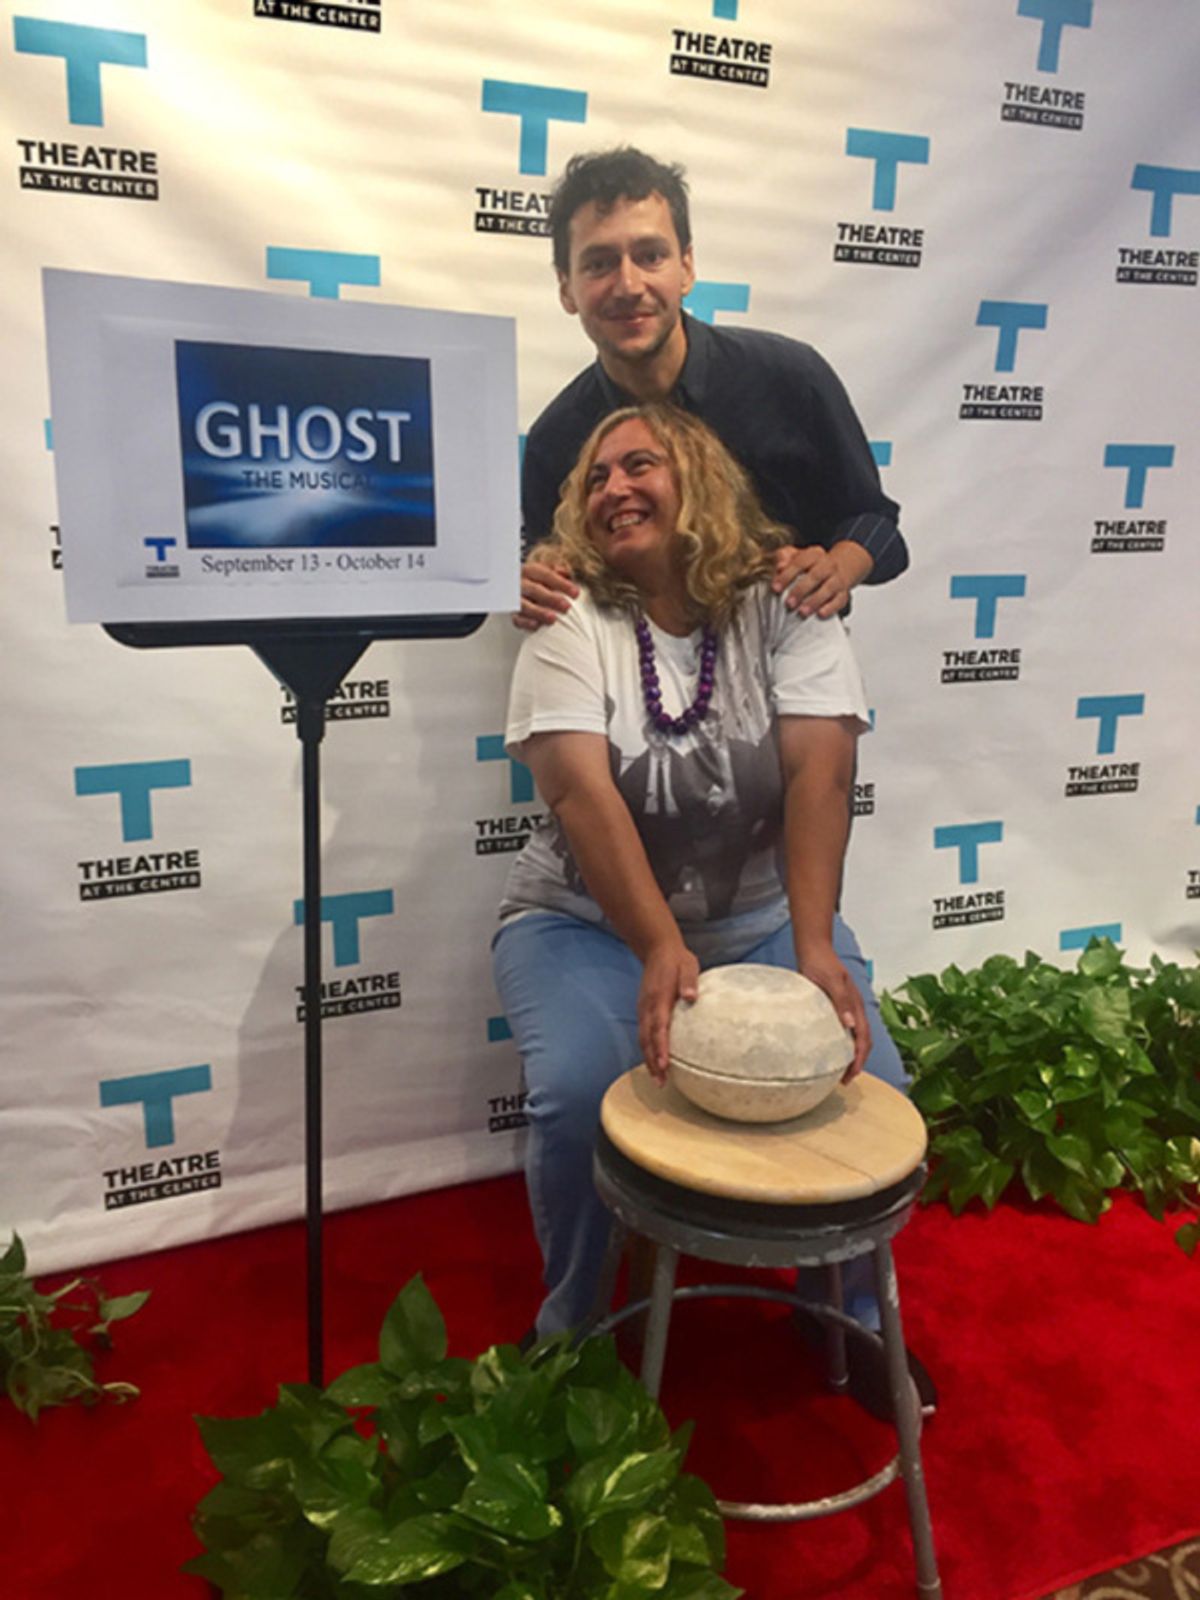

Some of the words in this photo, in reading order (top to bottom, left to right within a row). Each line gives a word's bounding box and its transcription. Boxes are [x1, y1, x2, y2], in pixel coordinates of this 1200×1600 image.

[281, 3, 311, 19] THE
[316, 7, 379, 27] CENTER
[672, 29, 772, 64] THEATRE
[672, 59, 688, 71] AT
[691, 62, 715, 76] THE
[718, 65, 767, 83] CENTER
[1003, 81, 1086, 111] THEATRE
[17, 139, 158, 175] THEATRE
[21, 171, 44, 185] AT
[49, 174, 82, 190] THE
[87, 178, 155, 196] CENTER
[475, 187, 553, 213] THEAT
[477, 217, 494, 229] AT
[499, 219, 524, 232] THE
[837, 222, 924, 247] THEATRE
[1118, 247, 1200, 267] THEATRE
[963, 384, 1044, 402] THEATRE
[195, 401, 411, 463] GHOST
[242, 470, 283, 490] THE
[1093, 520, 1168, 535] THEATRE
[201, 554, 294, 576] September
[302, 556, 320, 570] 13
[337, 554, 401, 571] October
[407, 554, 426, 570] 14
[943, 649, 1022, 666] THEATRE
[1067, 762, 1140, 780] THEATRE
[475, 814, 543, 836] THEAT
[78, 849, 200, 880] THEATRE
[82, 886, 101, 898] AT
[104, 882, 135, 895] THE
[140, 874, 199, 890] CENTER
[932, 890, 1005, 912] THEATRE
[102, 1150, 221, 1189] THEATRE
[107, 1193, 125, 1207] AT
[128, 1187, 159, 1201] THE
[162, 1174, 218, 1196] CENTER
